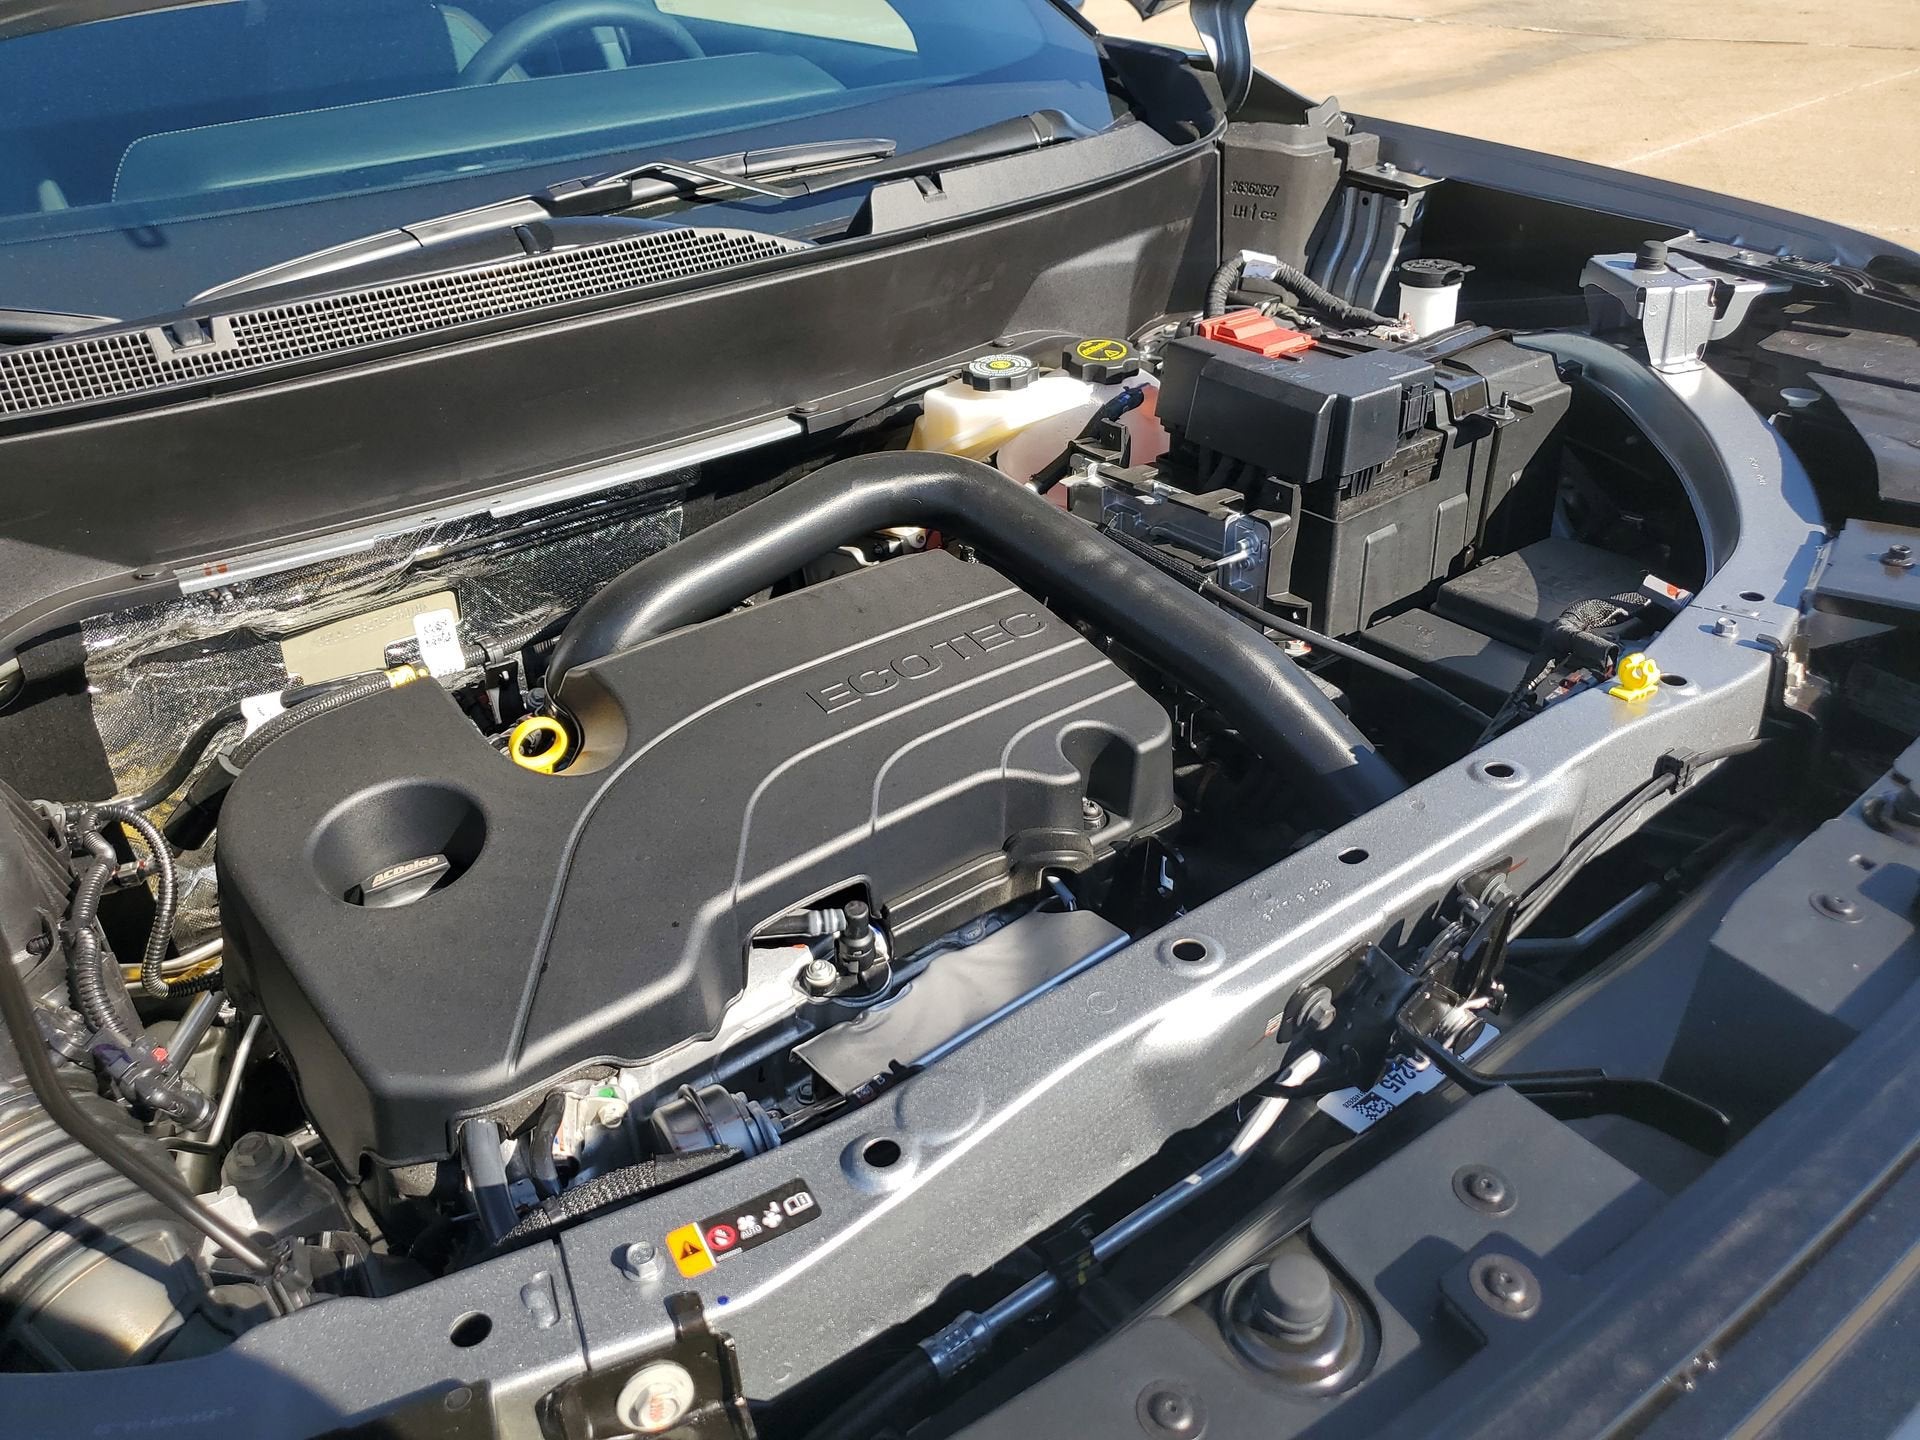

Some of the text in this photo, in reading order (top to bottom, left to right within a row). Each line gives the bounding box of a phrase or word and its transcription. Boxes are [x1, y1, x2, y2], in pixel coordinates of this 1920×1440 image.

[1232, 204, 1248, 219] LH
[805, 613, 1048, 715] ECOTEC
[372, 857, 439, 888] ACDelco
[742, 1224, 763, 1239] AUTO
